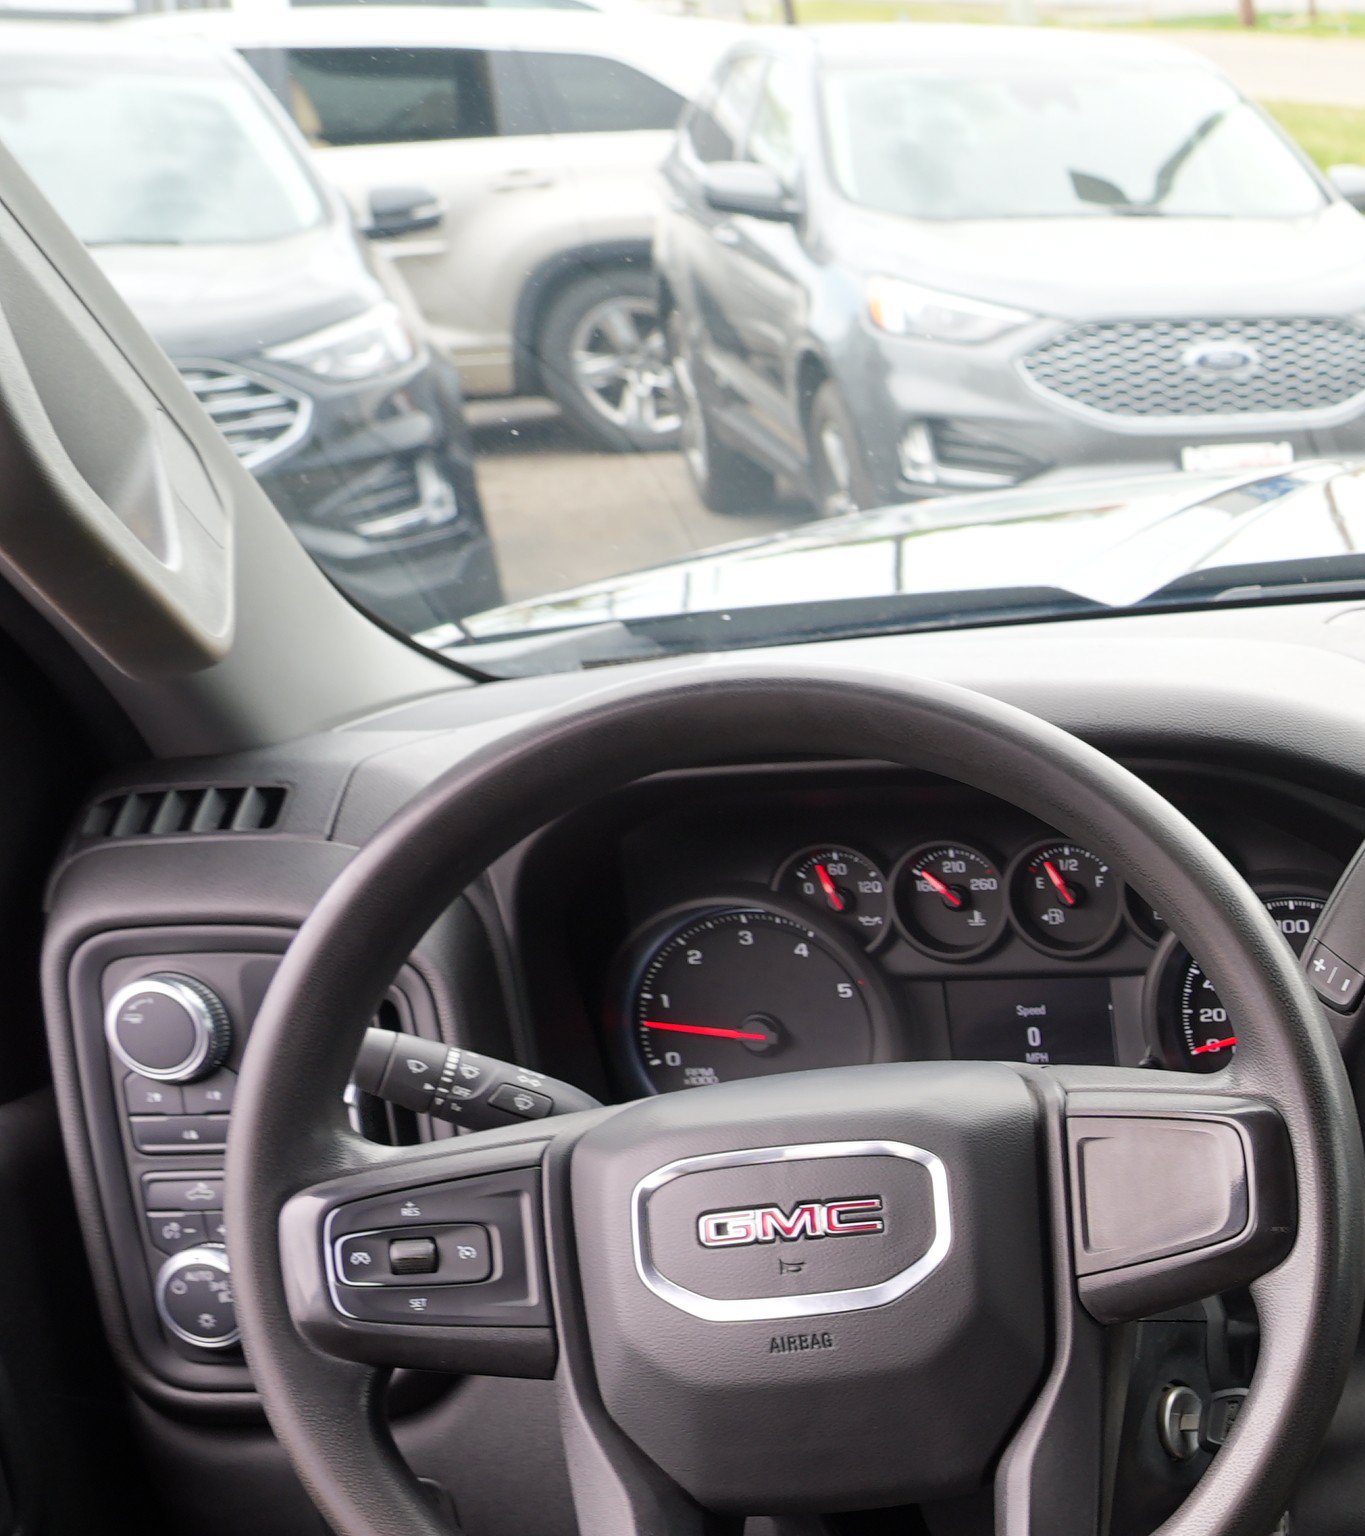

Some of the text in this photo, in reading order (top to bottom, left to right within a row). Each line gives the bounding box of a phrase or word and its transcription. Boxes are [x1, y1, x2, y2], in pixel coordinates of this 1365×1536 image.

[826, 863, 847, 876] 60
[942, 860, 967, 873] 210
[1058, 859, 1080, 872] 1/2
[803, 881, 815, 895] 0
[858, 880, 883, 894] 120
[970, 878, 998, 891] 260
[1035, 876, 1045, 889] E
[1095, 876, 1105, 888] F
[738, 930, 754, 946] 3
[686, 949, 703, 965] 2
[793, 942, 809, 958] 4
[837, 982, 853, 998] 5
[660, 993, 670, 1009] 1
[1016, 1004, 1047, 1017] Speed
[1199, 1008, 1227, 1023] 20
[1027, 1026, 1042, 1047] 0
[664, 1051, 682, 1067] 0
[1026, 1052, 1049, 1063] MPH
[685, 1067, 715, 1078] RPM
[401, 1207, 421, 1217] RES
[697, 1194, 885, 1249] GMC
[409, 1298, 428, 1307] SET
[769, 1332, 834, 1354] AIRBAG
